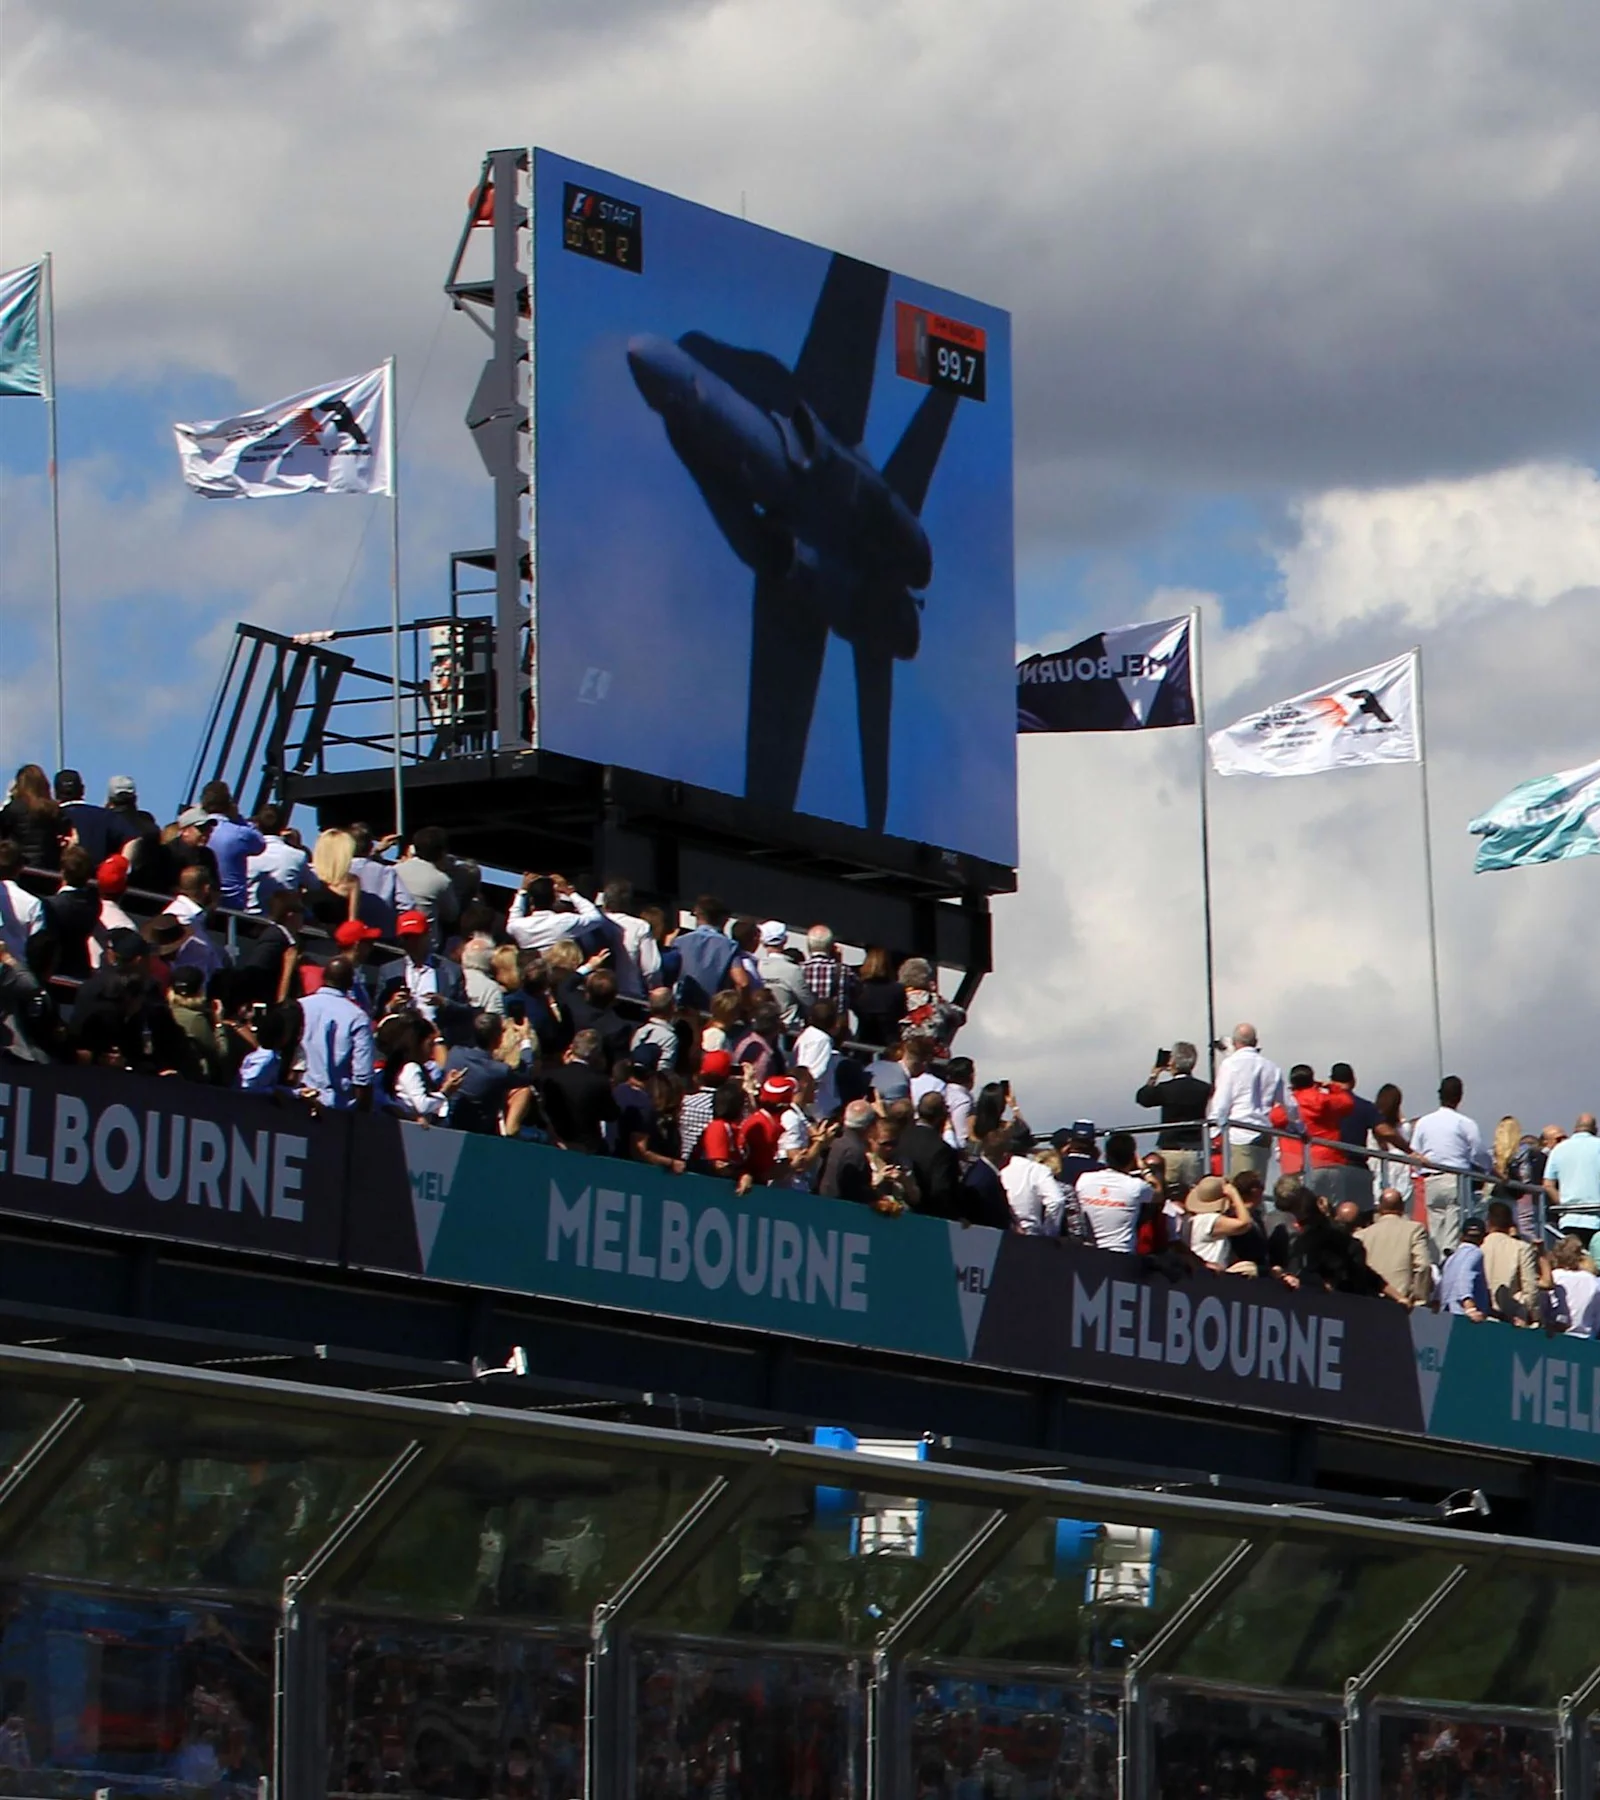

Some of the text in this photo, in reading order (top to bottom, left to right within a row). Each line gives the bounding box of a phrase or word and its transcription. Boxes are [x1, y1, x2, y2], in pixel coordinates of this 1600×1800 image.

[937, 347, 977, 385] 99.7
[0, 1083, 308, 1222] LBOURNE
[411, 1172, 448, 1201] MEL
[545, 1178, 870, 1312] MELBOURNE
[957, 1264, 988, 1295] MEL
[1071, 1271, 1344, 1391] MELBOURNE
